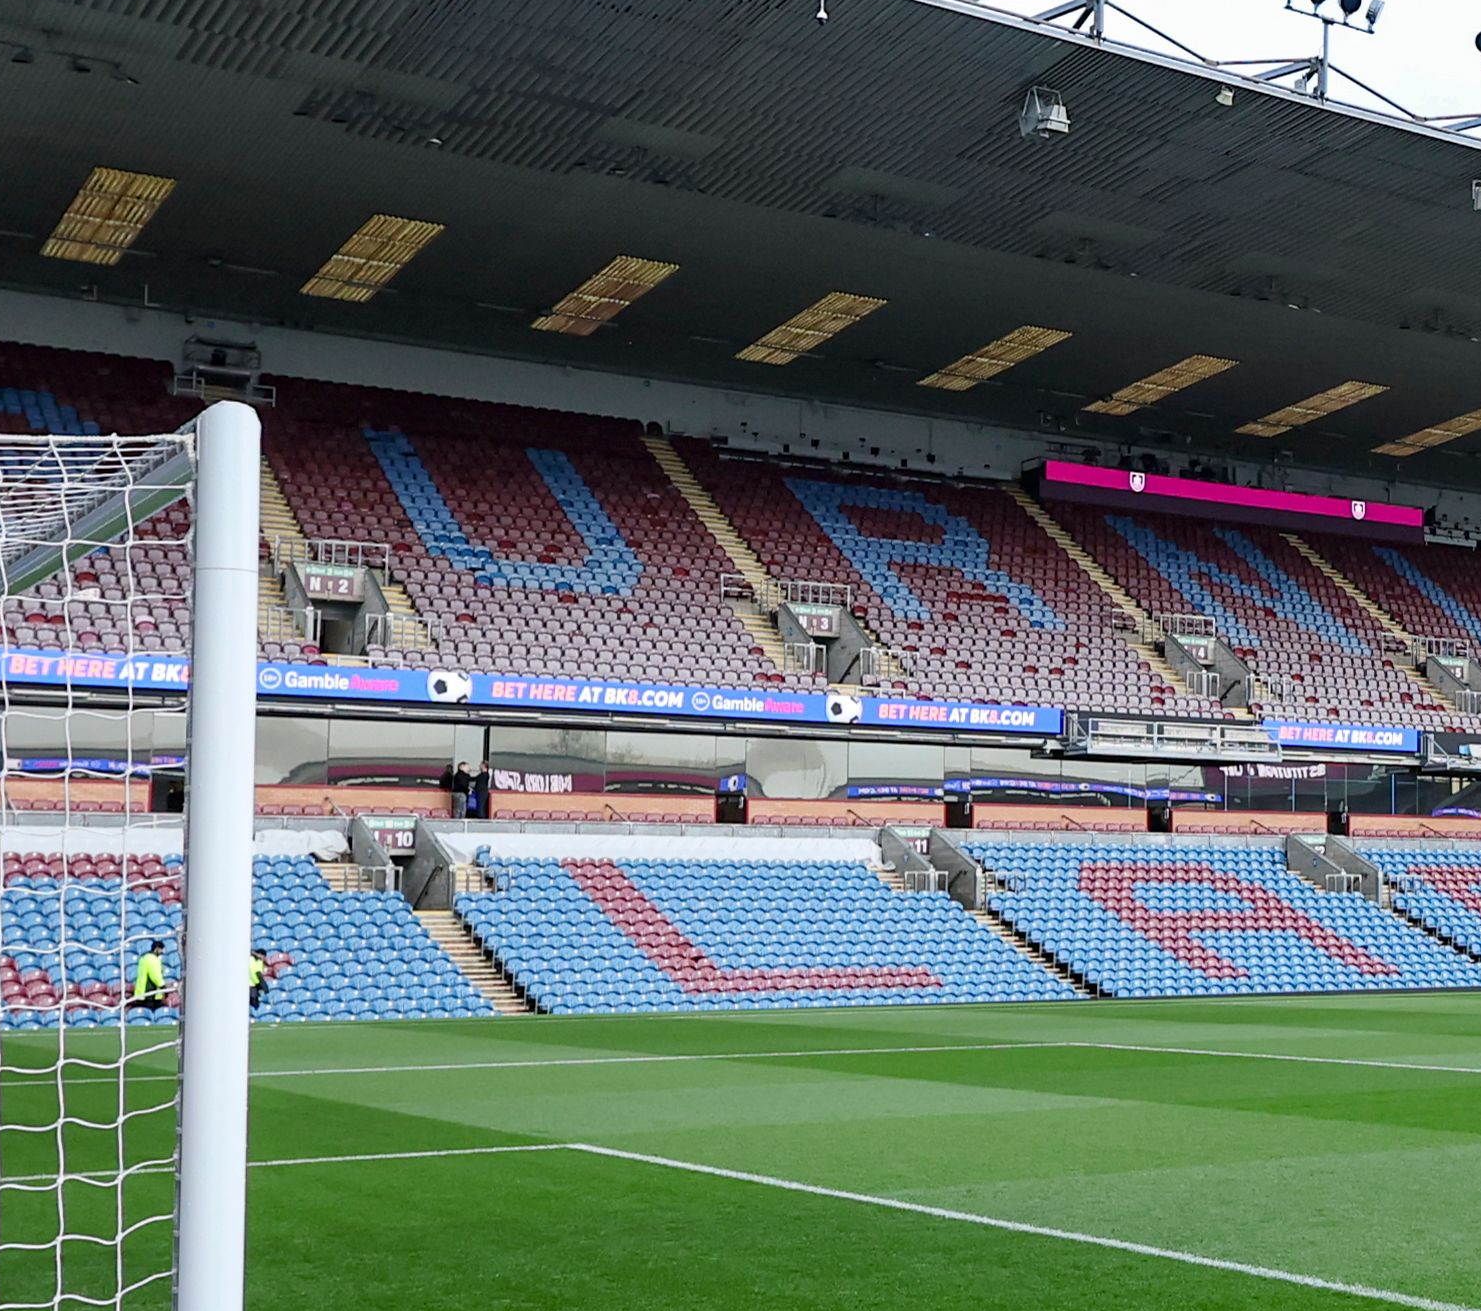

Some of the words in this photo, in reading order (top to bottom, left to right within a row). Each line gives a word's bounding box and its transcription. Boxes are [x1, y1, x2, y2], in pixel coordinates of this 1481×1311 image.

[310, 576, 321, 591] N
[338, 579, 349, 594] 2
[820, 617, 829, 630] 3
[9, 654, 55, 676] BET
[60, 657, 116, 679] HERE
[118, 660, 148, 681] AT
[491, 681, 527, 699] BET
[529, 683, 577, 702] HERE
[577, 687, 602, 703] AT
[603, 688, 684, 709] BK8.COM
[878, 703, 907, 719] BET
[908, 705, 948, 722] HERE
[948, 708, 970, 723] AT
[970, 709, 1035, 727] BK8.COM
[1278, 725, 1303, 741] BET
[1303, 727, 1334, 743] HERE
[1334, 729, 1350, 744] AT
[395, 831, 413, 847] 10
